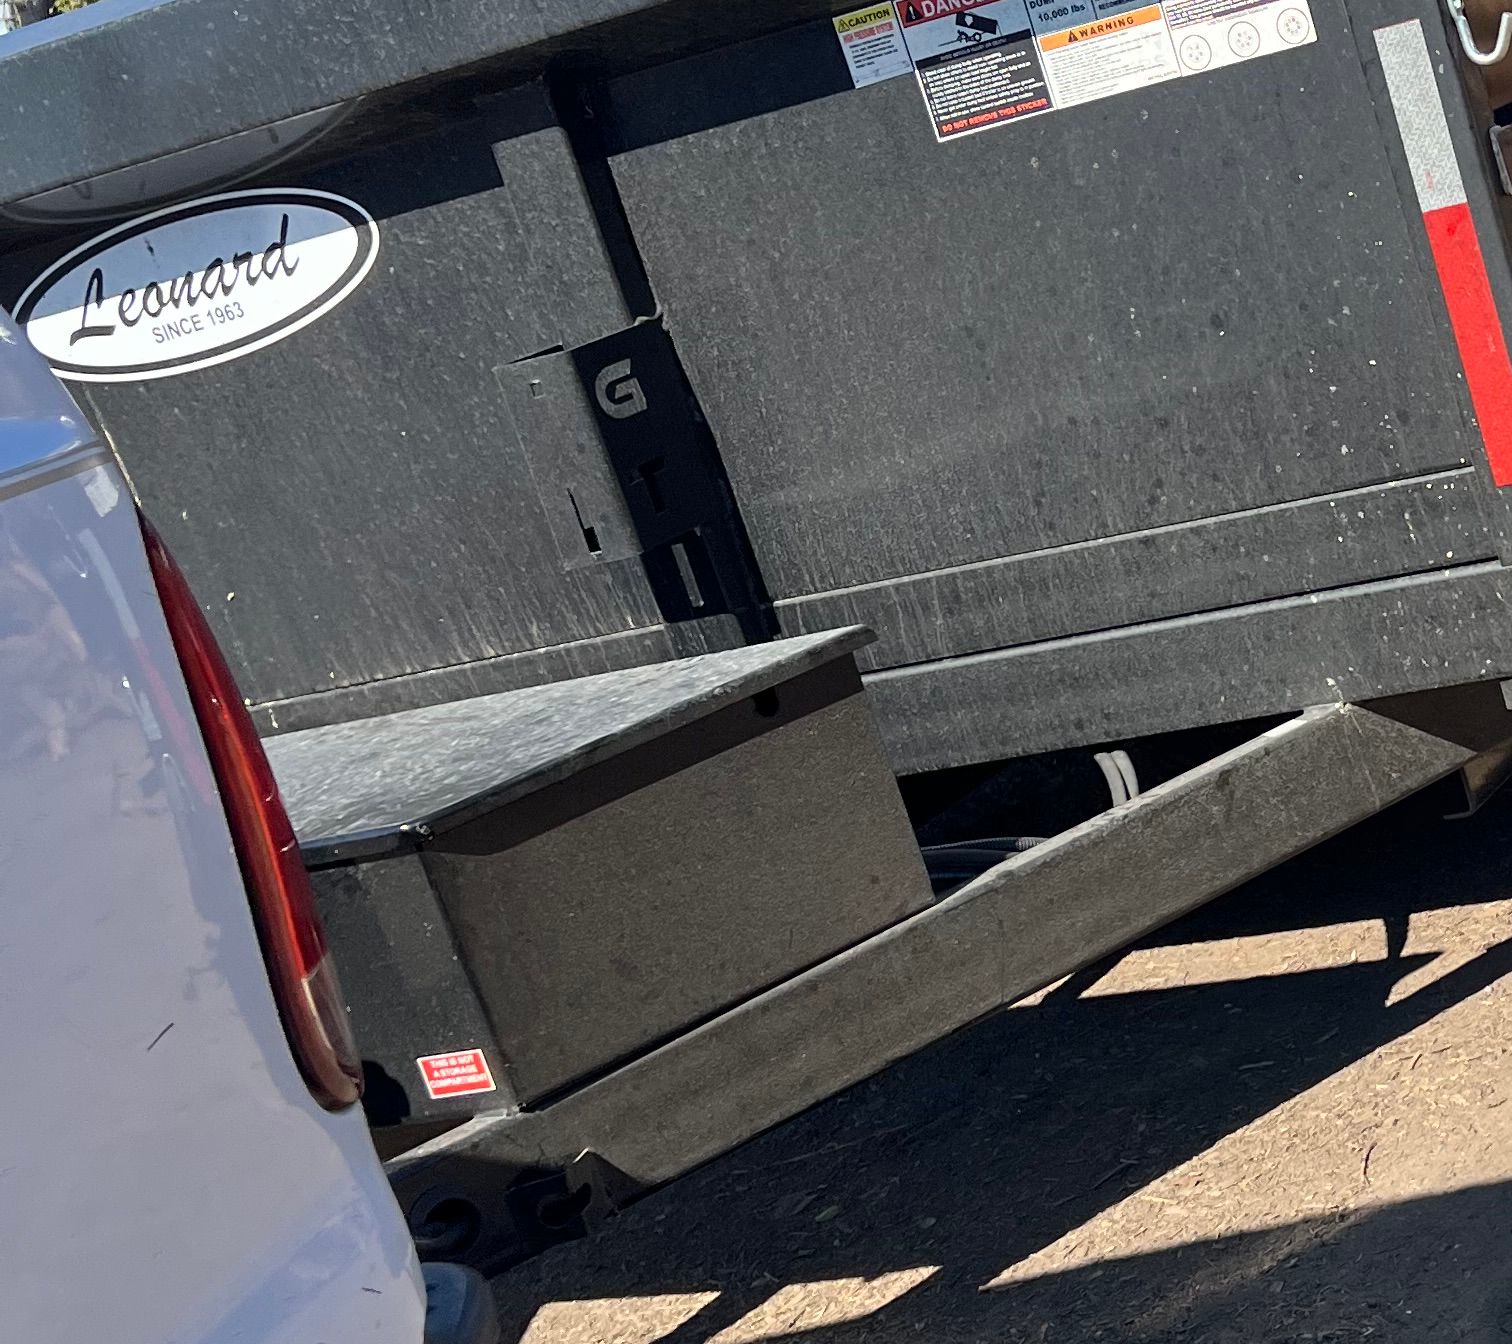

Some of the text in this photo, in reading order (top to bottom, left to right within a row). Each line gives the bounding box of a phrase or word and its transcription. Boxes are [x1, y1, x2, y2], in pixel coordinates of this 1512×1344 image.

[848, 9, 890, 27] CAUTION
[1038, 3, 1086, 22] 10,000 lbs
[1079, 16, 1135, 37] WARNING
[70, 213, 299, 346] Leonard
[152, 301, 245, 344] SINCE 1963
[594, 358, 648, 419] G
